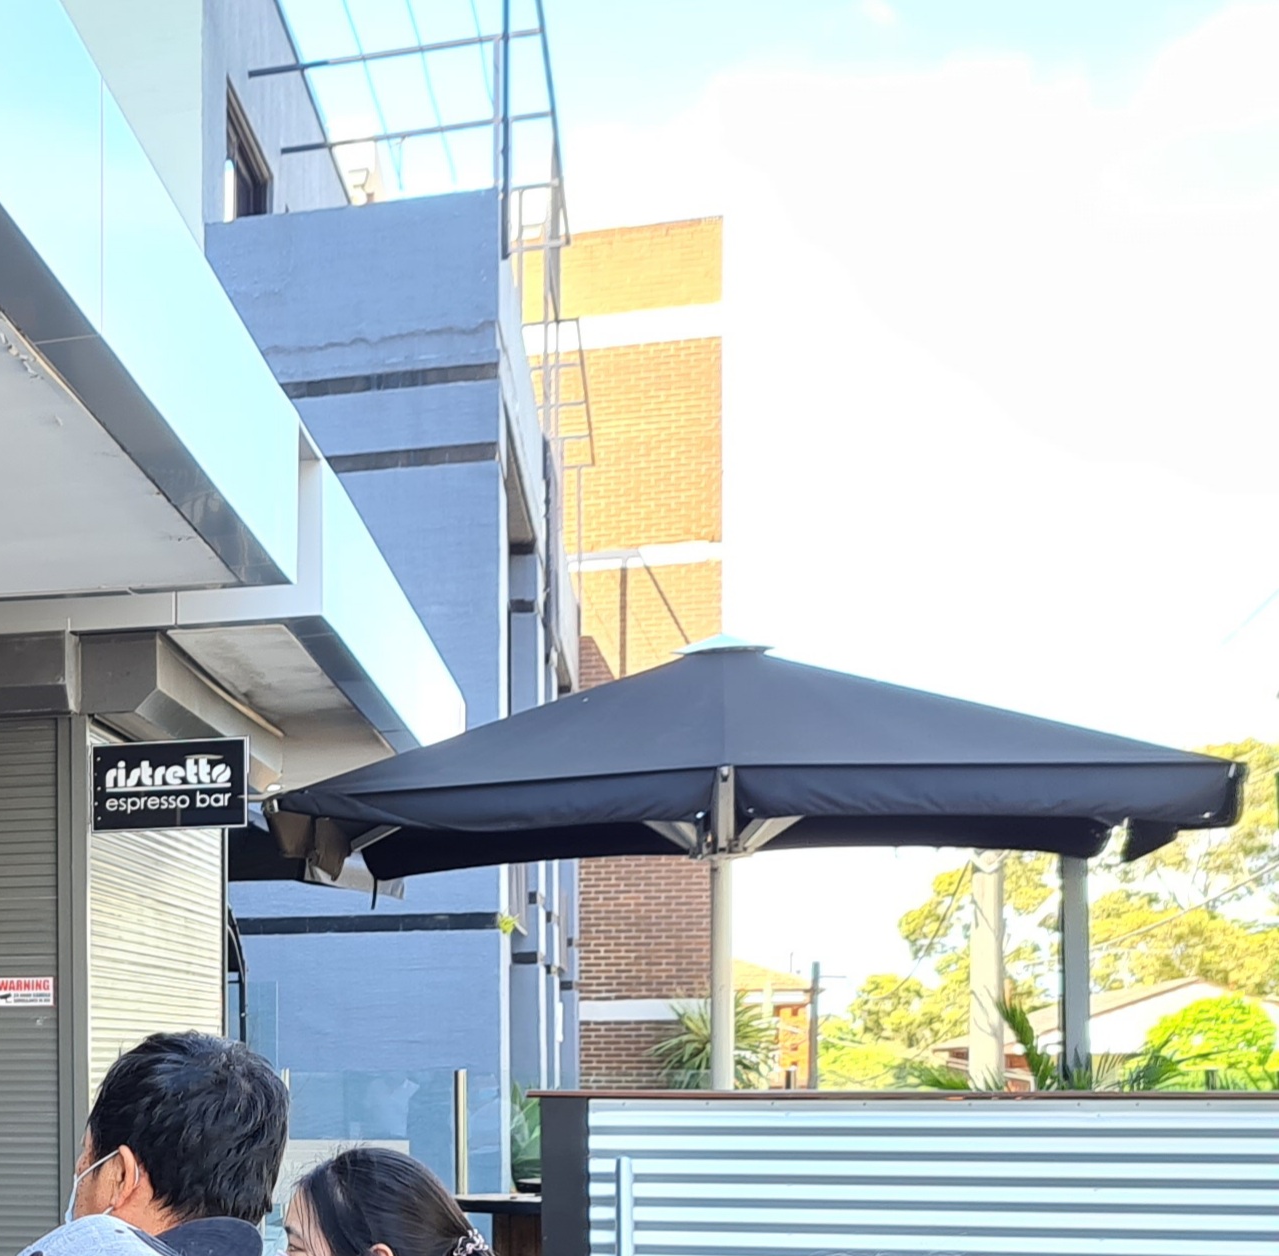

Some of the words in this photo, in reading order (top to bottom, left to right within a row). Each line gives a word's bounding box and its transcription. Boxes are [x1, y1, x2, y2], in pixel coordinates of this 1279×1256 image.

[105, 756, 232, 787] ristretto
[105, 794, 190, 814] espresso
[196, 790, 232, 808] bar
